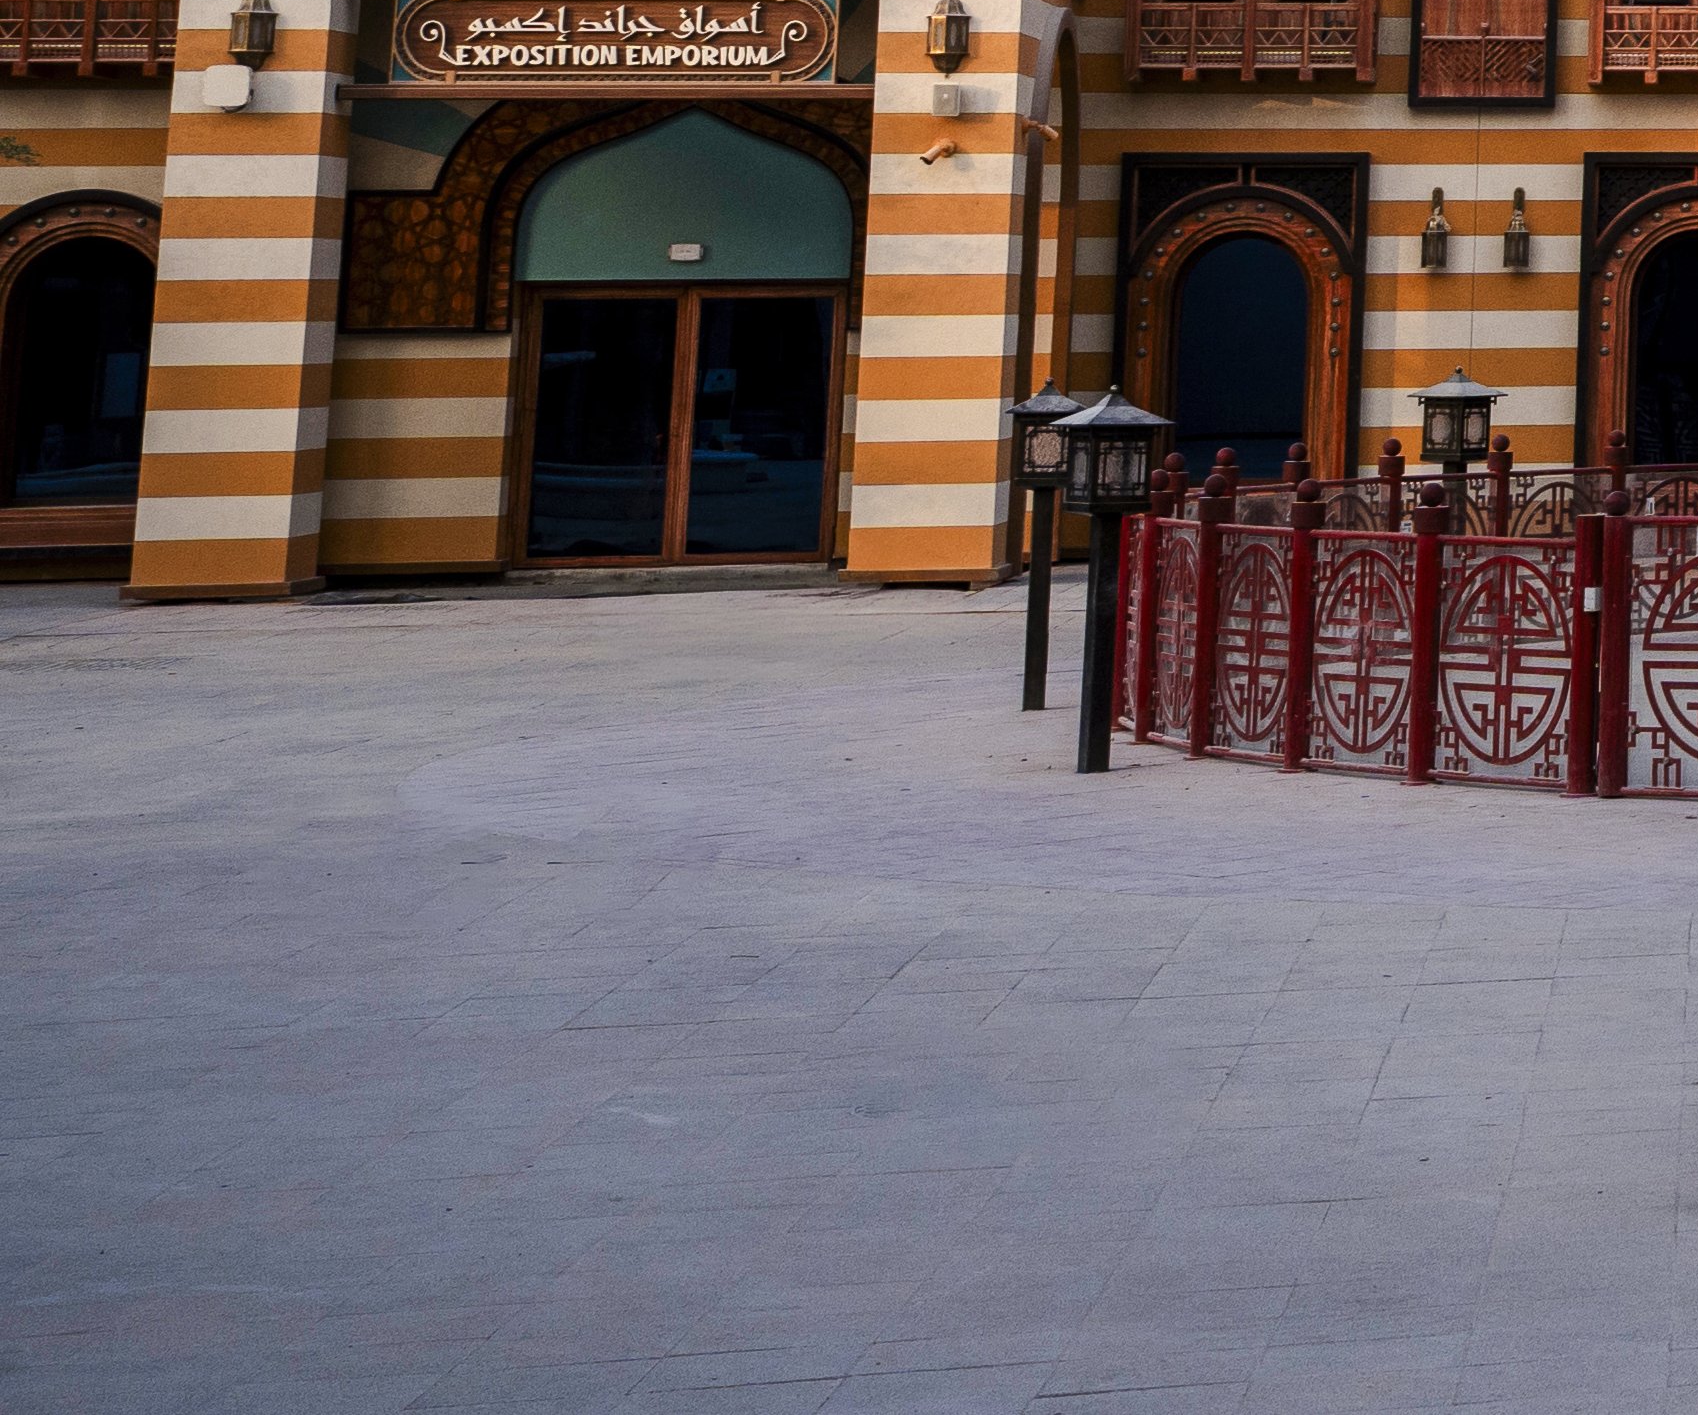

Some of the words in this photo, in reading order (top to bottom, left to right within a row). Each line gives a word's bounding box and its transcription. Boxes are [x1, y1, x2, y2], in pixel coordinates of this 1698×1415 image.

[464, 5, 571, 42] إكسبو
[576, 4, 666, 41] جراند
[670, 1, 765, 42] أسواق
[455, 44, 618, 67] EXPOSITION
[625, 44, 769, 67] EMPORIUM
